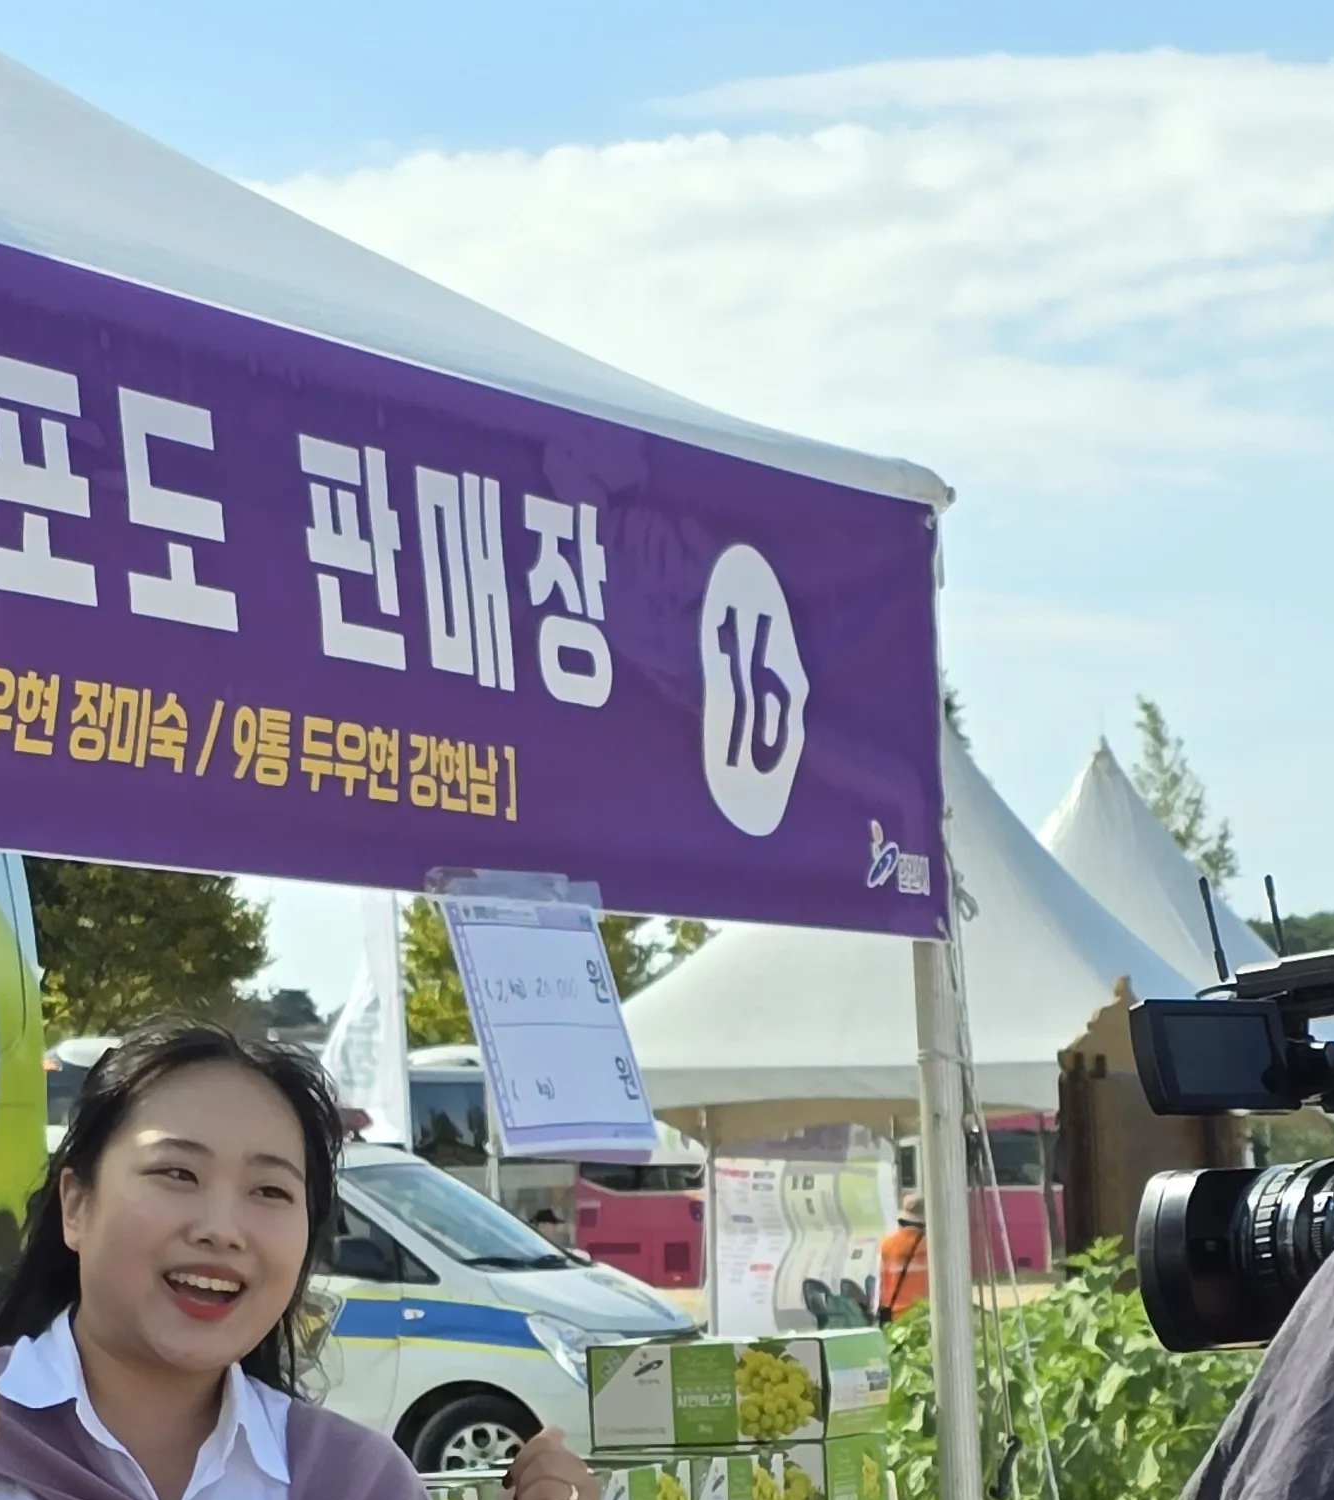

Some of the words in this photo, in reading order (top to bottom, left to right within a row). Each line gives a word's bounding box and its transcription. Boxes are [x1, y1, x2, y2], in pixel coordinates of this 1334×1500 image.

[298, 434, 612, 708] 판매장
[69, 679, 188, 774] 장미숙
[233, 705, 291, 787] 9통
[300, 715, 399, 803] 두우현
[717, 605, 791, 774] 16
